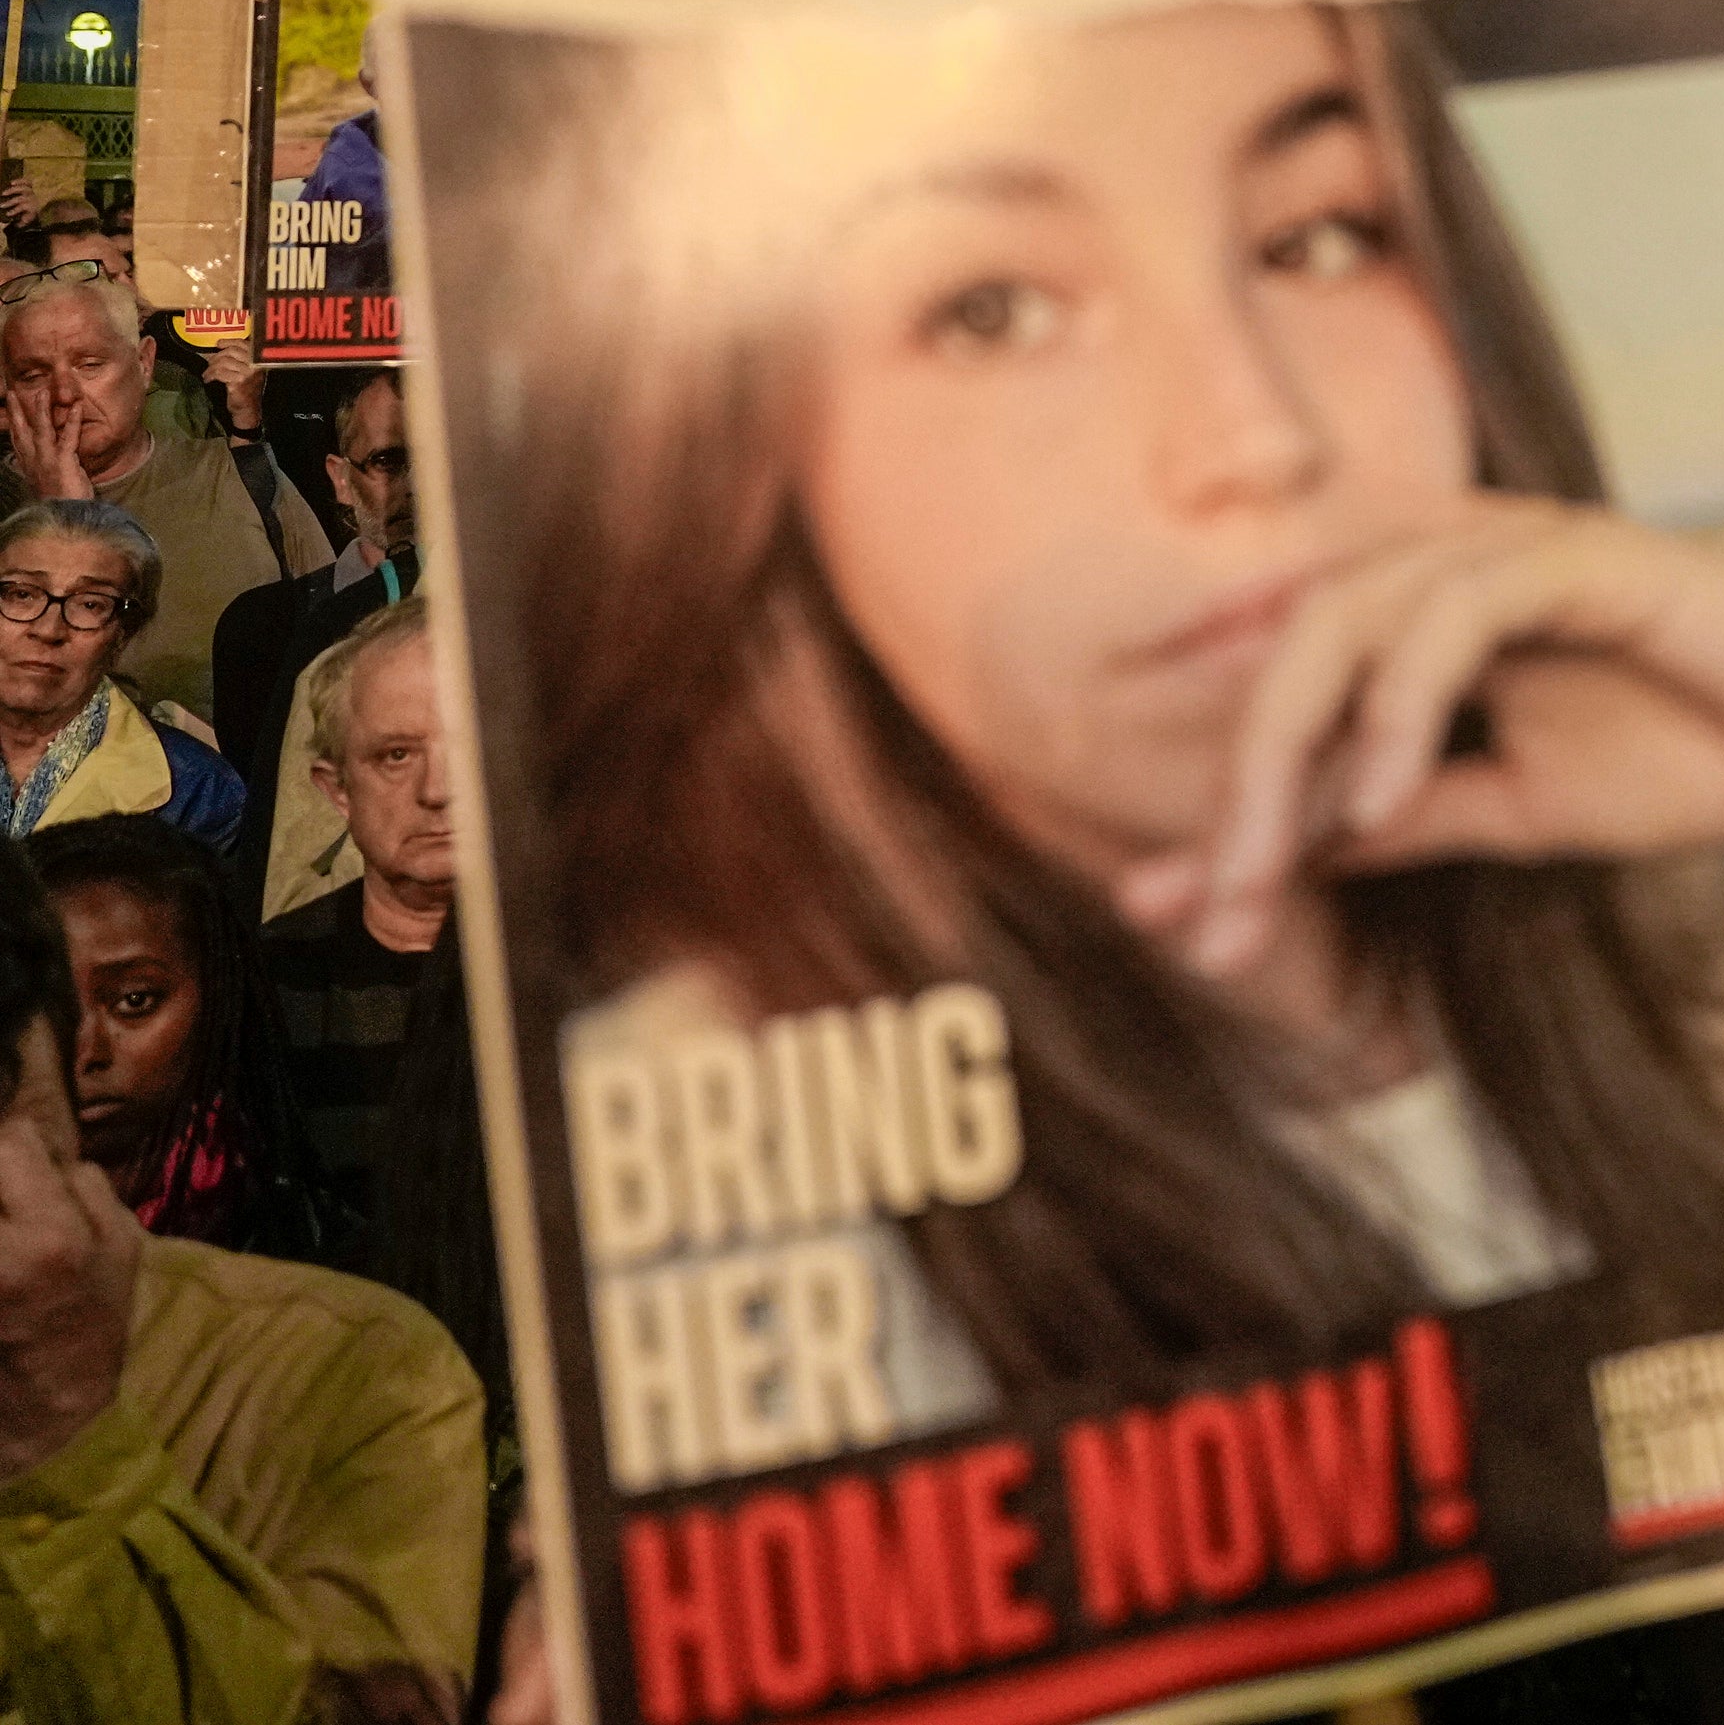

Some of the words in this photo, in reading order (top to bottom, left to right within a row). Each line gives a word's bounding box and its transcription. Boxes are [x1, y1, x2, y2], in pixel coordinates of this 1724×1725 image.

[267, 247, 327, 291] HIM
[269, 200, 363, 244] BRING
[265, 296, 354, 341] HOME
[361, 295, 403, 339] NO
[562, 983, 1024, 1260] BRING
[601, 1236, 900, 1494] HER
[624, 1439, 1052, 1725] HOME
[1062, 1314, 1480, 1626] NOW!
